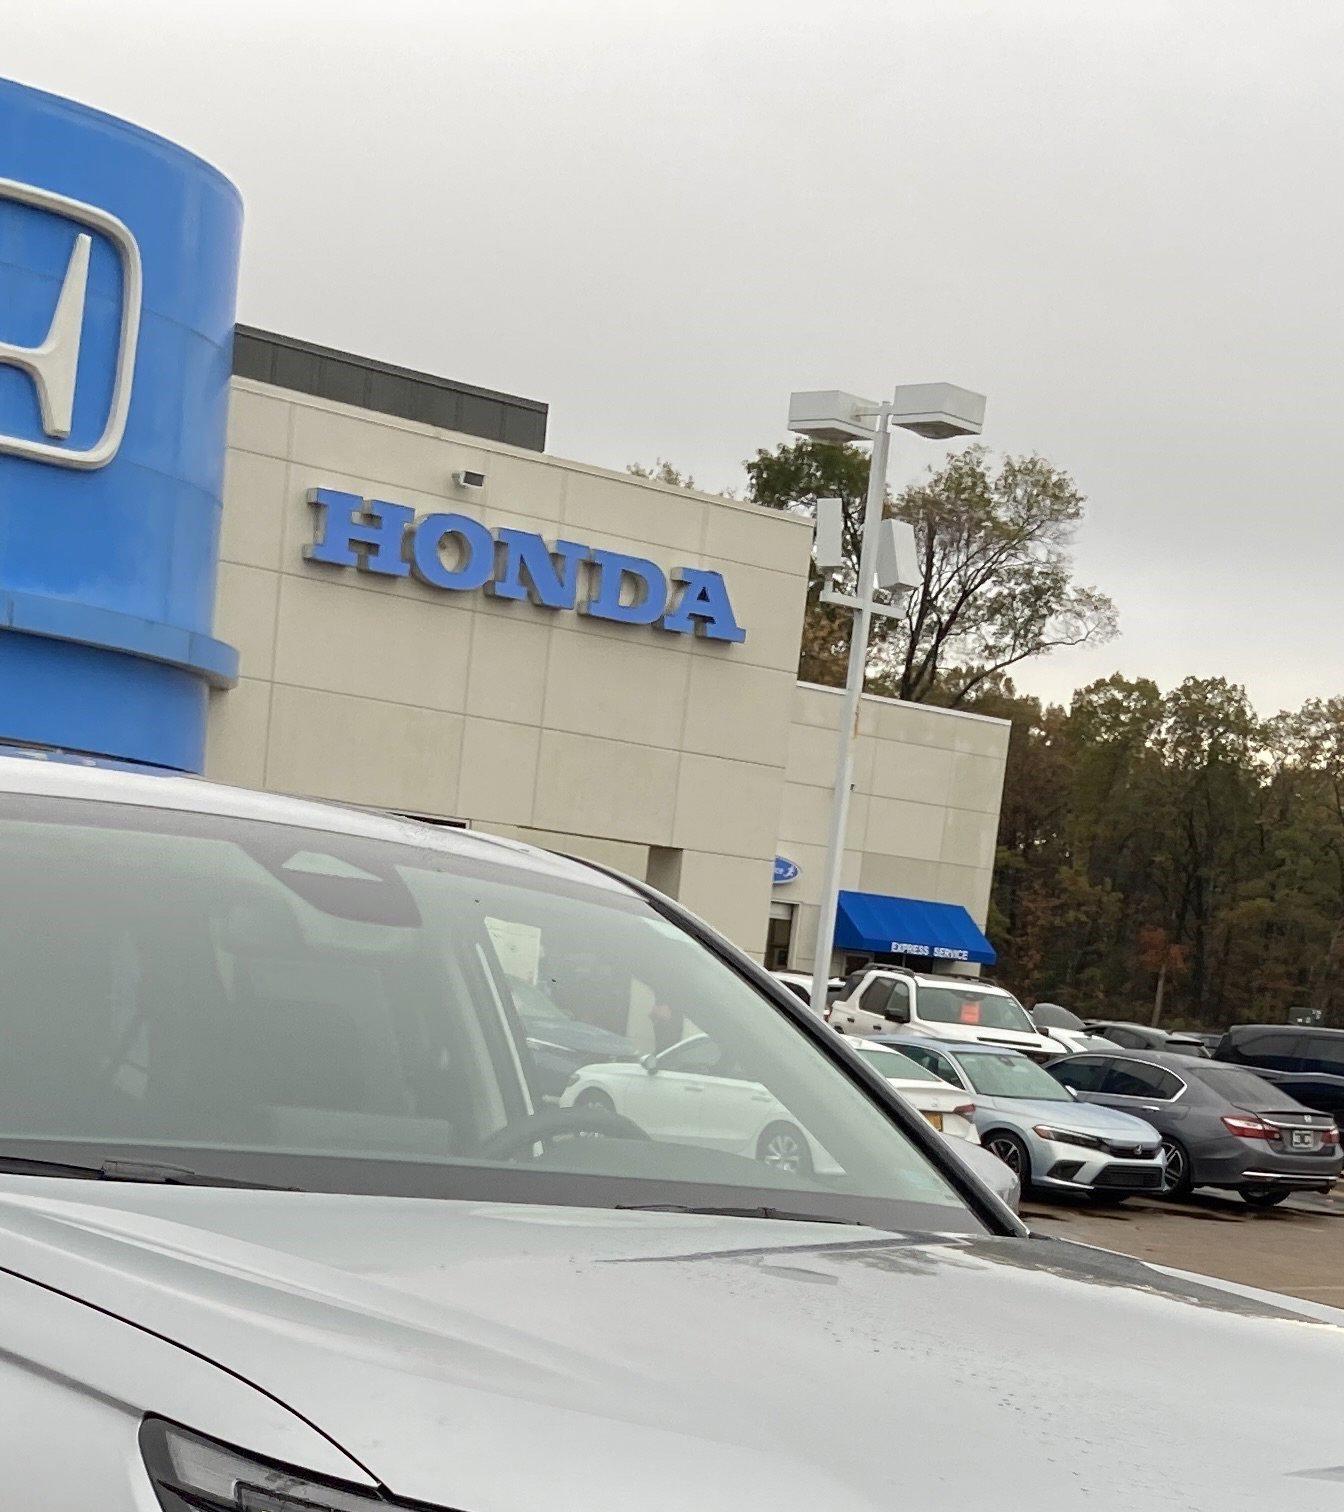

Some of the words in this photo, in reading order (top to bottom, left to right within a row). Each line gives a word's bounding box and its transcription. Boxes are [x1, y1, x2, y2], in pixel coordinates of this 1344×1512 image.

[303, 487, 746, 644] HONDA
[890, 941, 929, 956] EXPRESS
[933, 946, 969, 960] SERVICE
